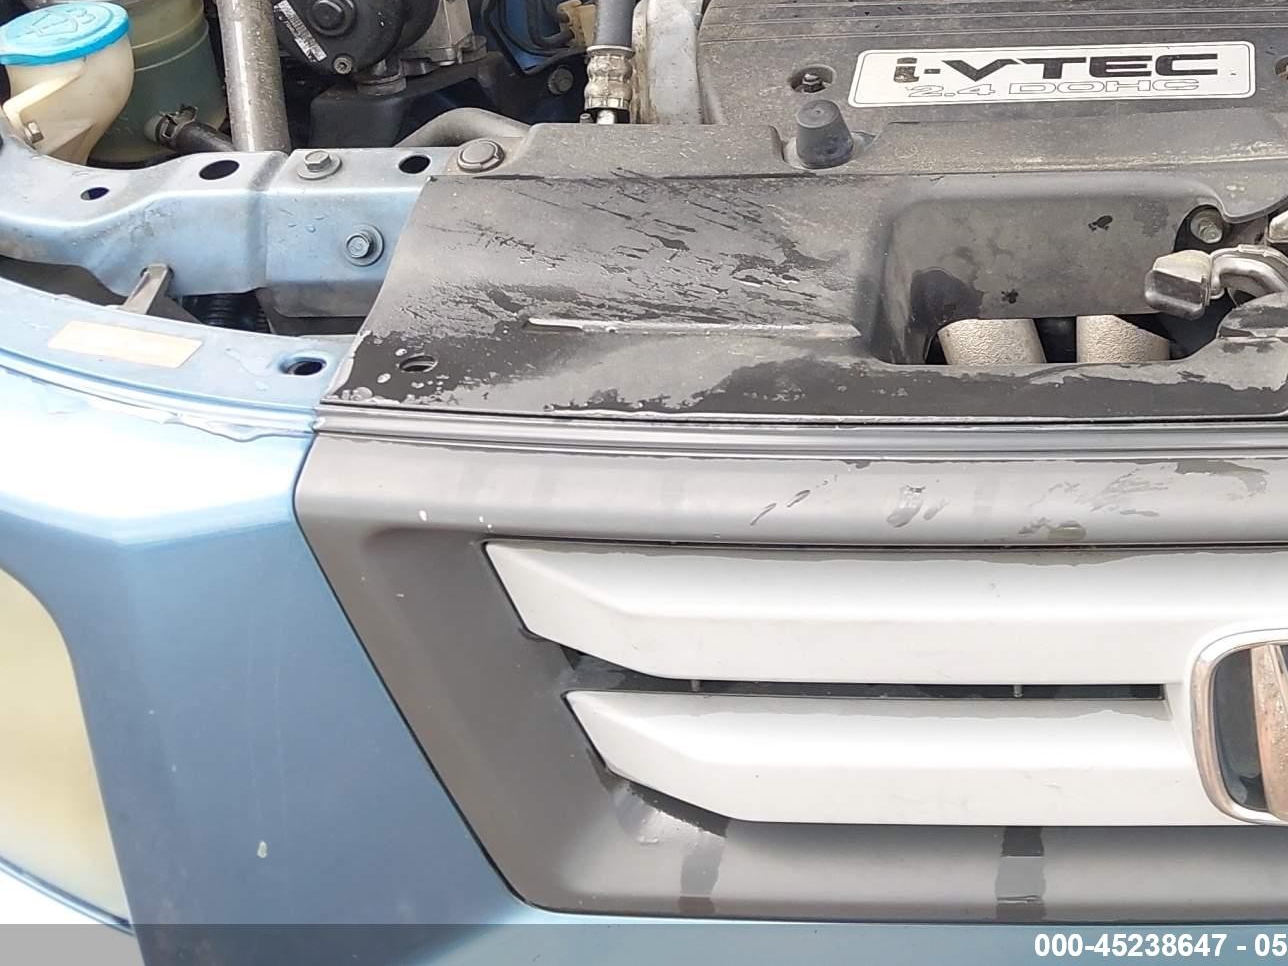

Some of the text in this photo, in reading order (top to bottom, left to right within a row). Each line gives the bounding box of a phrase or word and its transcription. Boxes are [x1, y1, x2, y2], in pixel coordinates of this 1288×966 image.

[893, 53, 1218, 83] i-VTEC
[906, 79, 1200, 98] 2.4 DOHC
